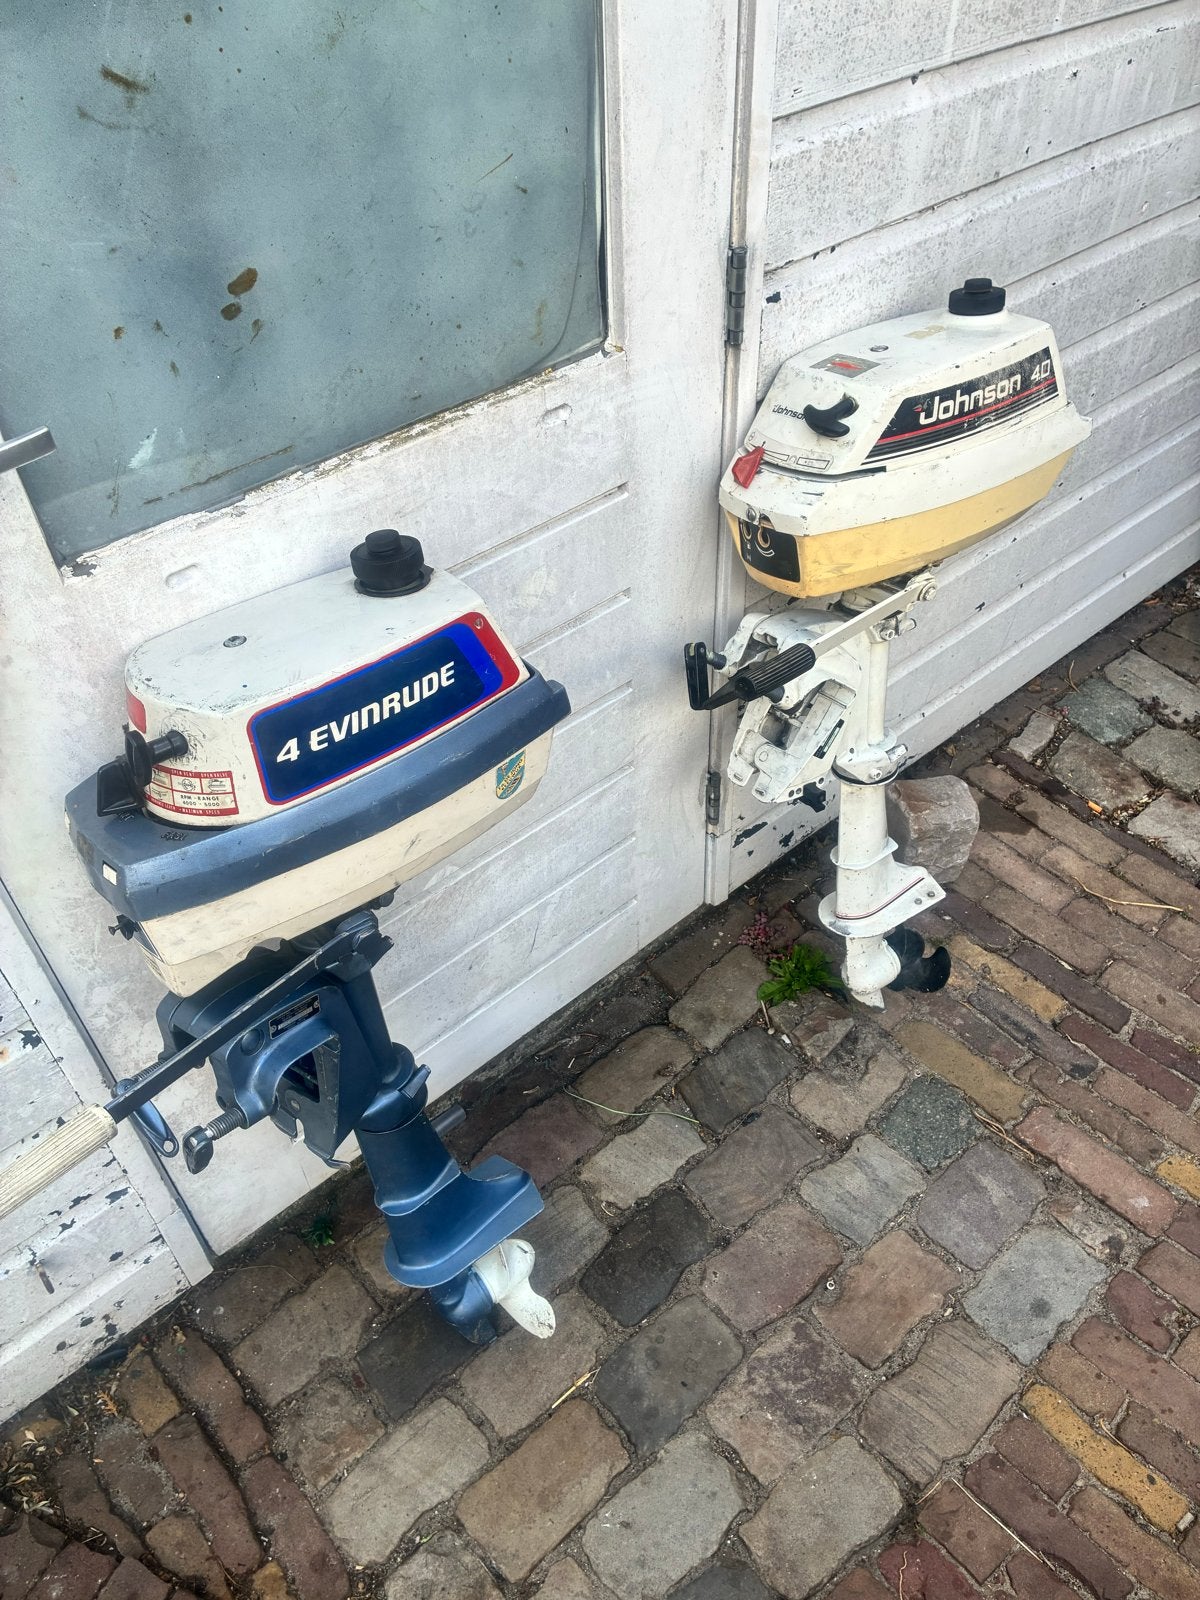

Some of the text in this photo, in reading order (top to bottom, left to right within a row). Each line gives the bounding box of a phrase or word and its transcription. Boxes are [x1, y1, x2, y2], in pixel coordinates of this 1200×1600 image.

[918, 373, 1022, 426] Johnson
[276, 660, 455, 763] 4 EVINRUDE
